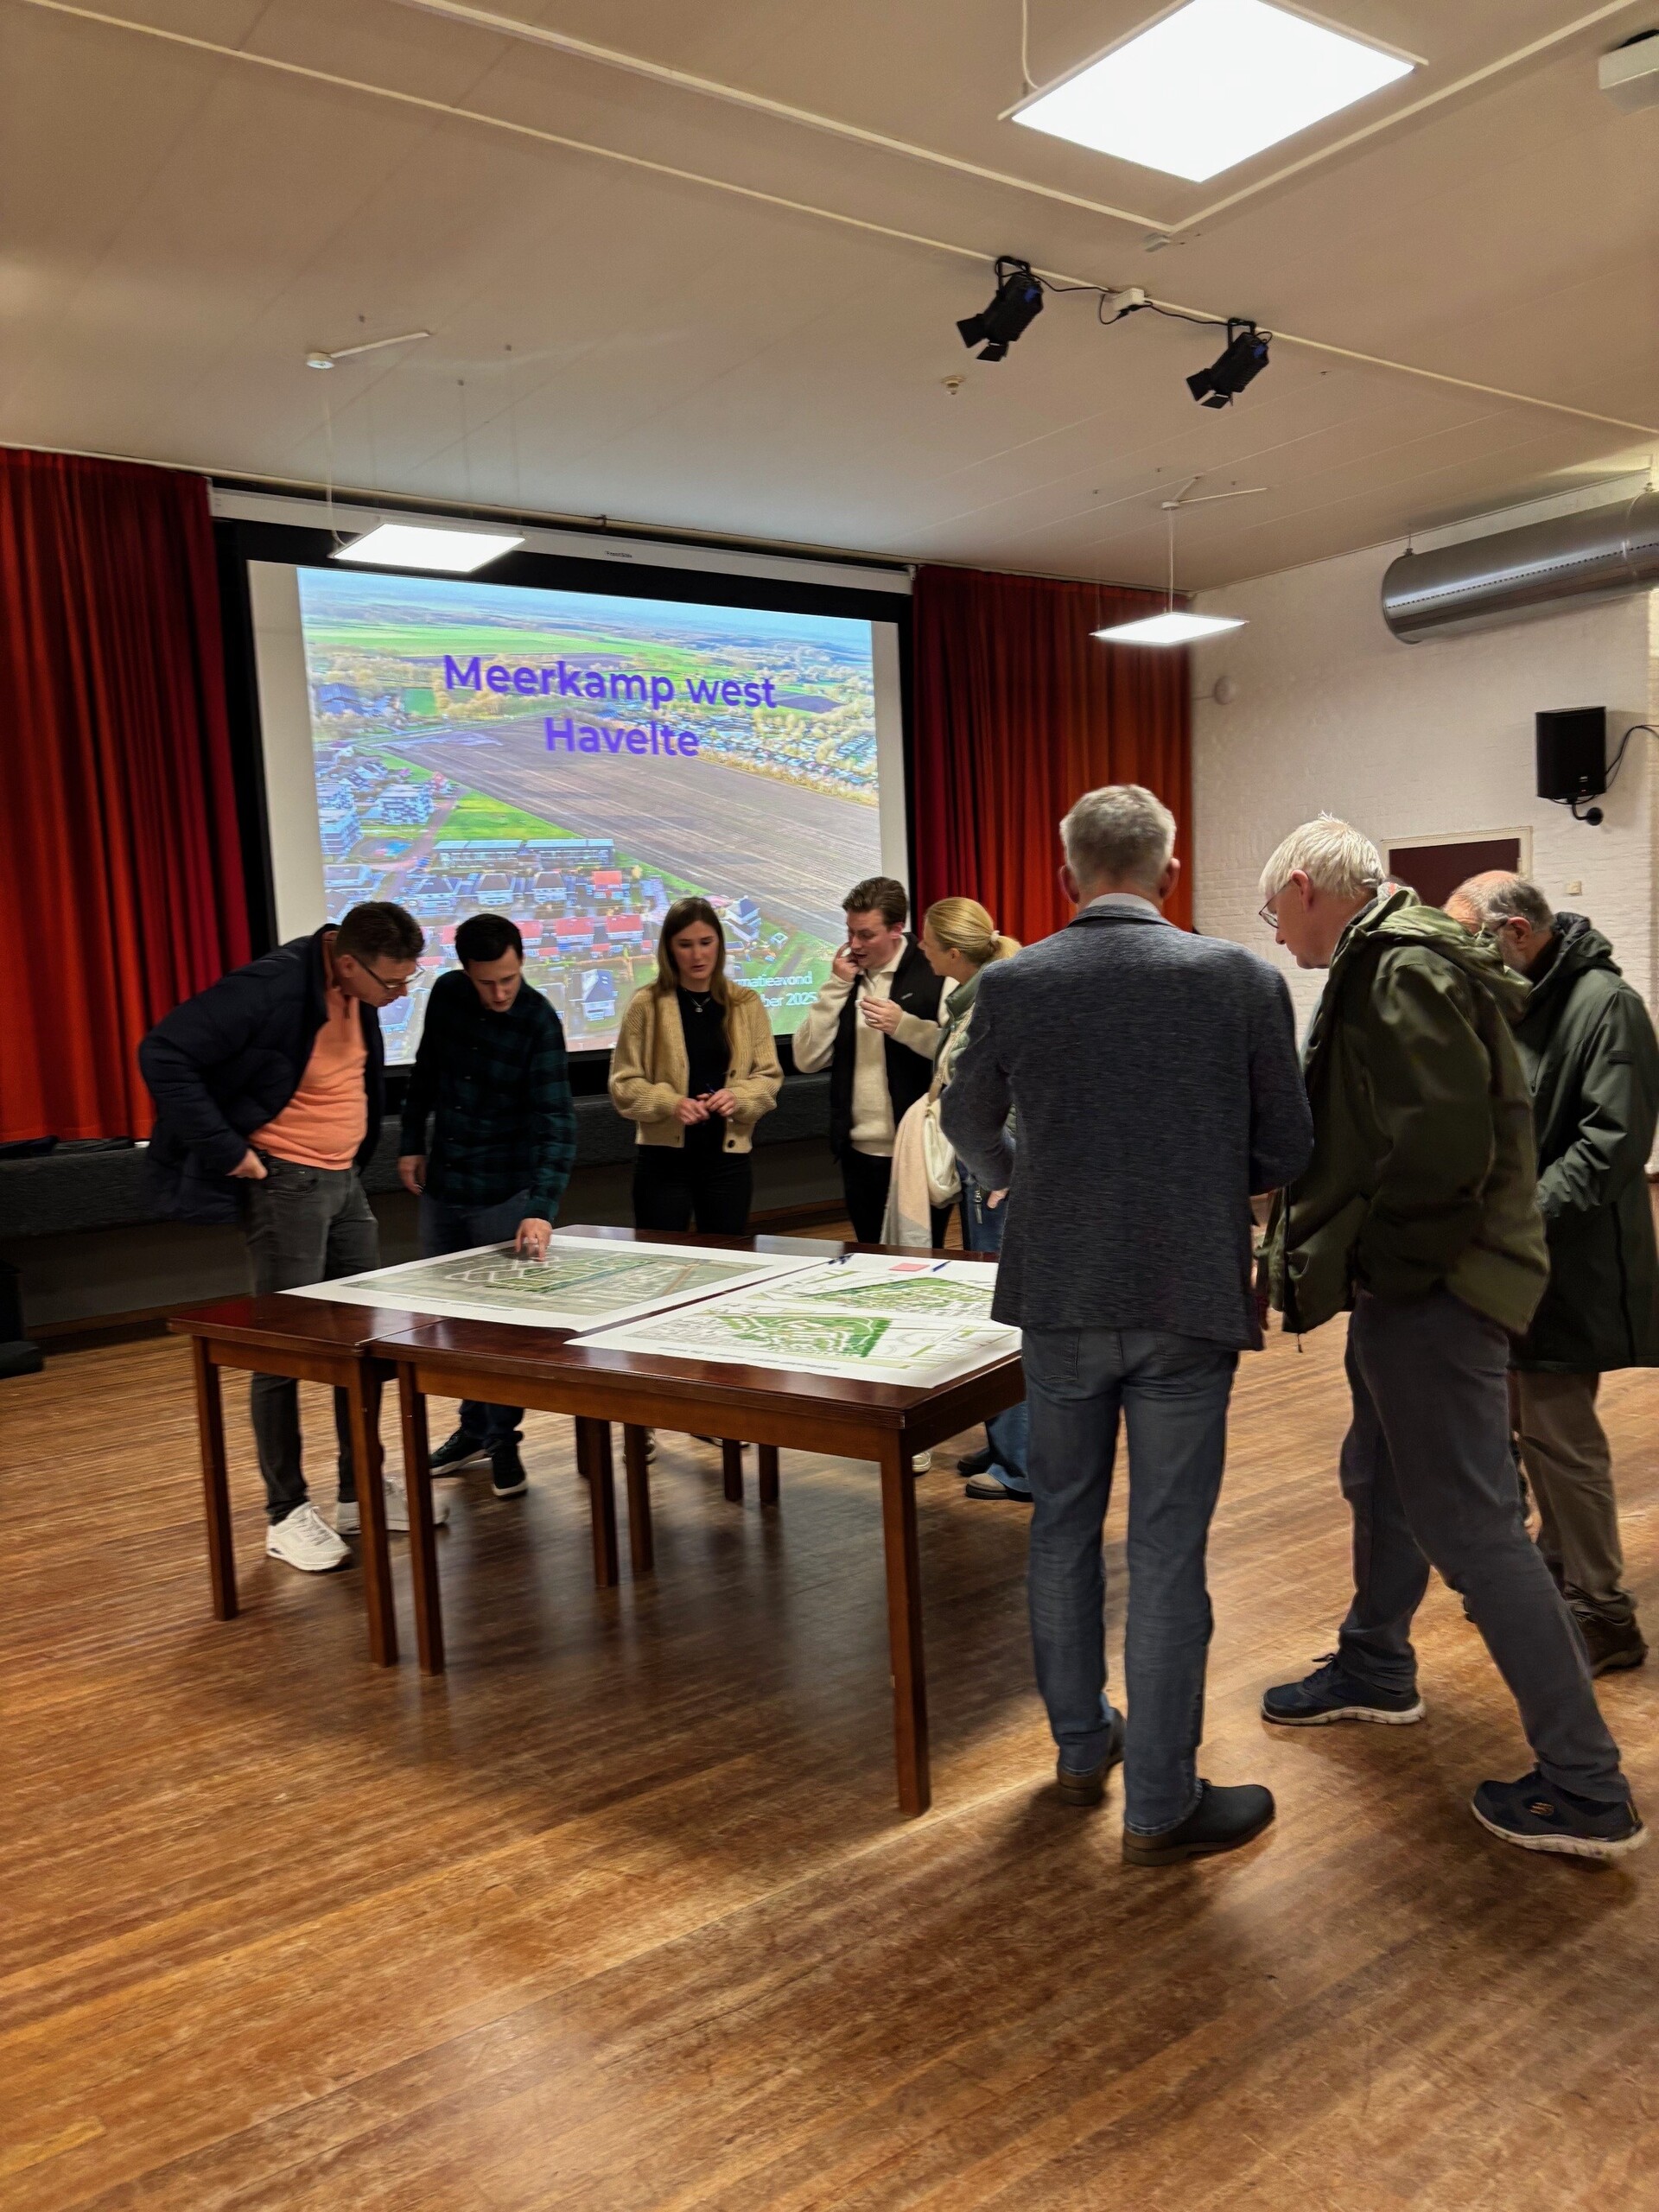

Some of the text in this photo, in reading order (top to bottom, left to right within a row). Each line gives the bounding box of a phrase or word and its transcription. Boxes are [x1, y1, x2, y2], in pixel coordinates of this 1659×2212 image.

[443, 654, 778, 710] Meerkamp west
[543, 716, 700, 757] Havelte
[760, 991, 818, 1007] ber 2025
